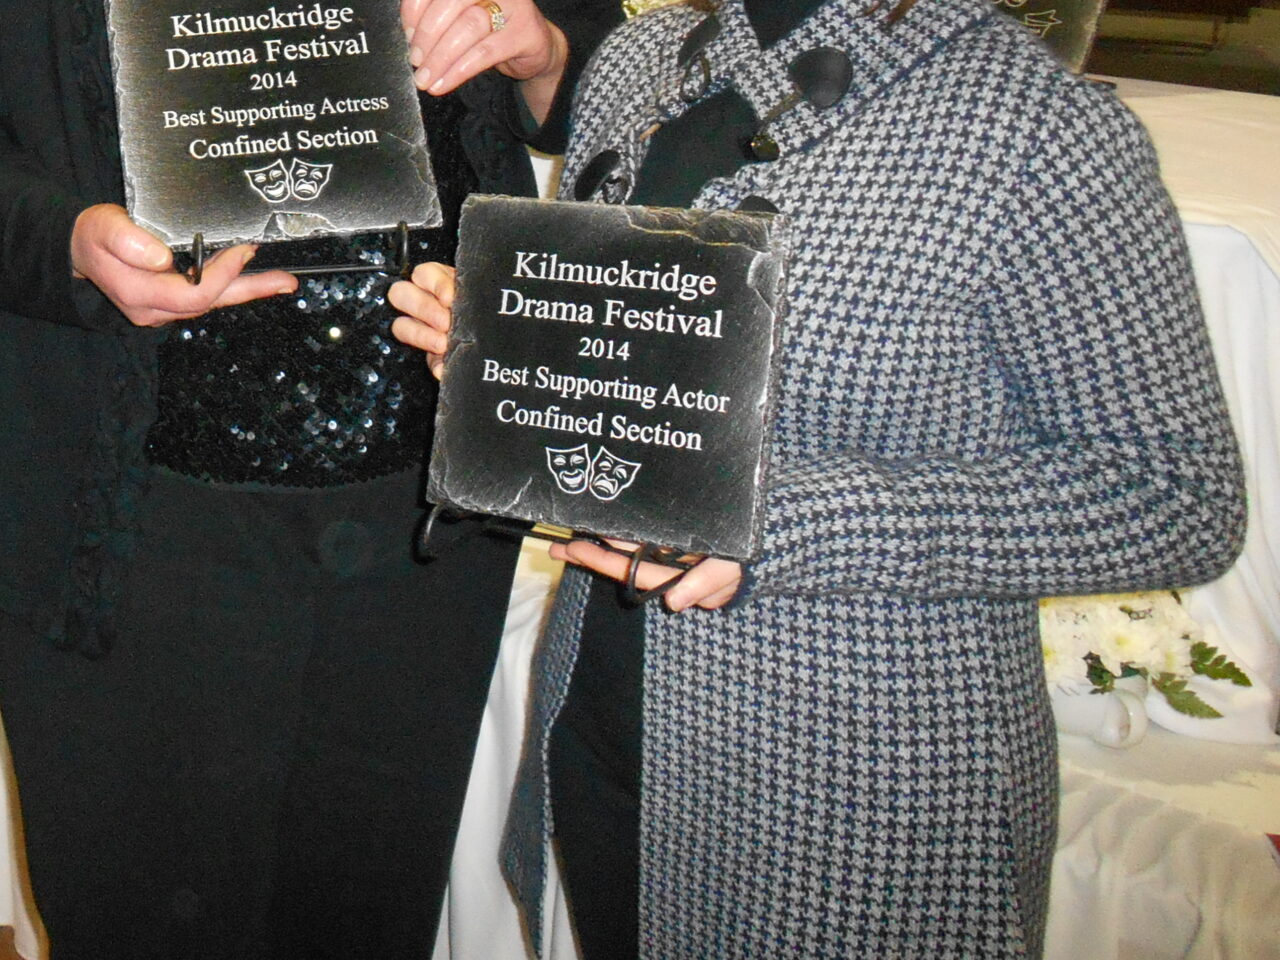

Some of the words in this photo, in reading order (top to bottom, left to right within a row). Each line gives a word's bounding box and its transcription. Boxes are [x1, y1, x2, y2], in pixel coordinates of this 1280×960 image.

[170, 3, 354, 38] Kilmuckridge
[165, 47, 258, 70] Drama
[264, 31, 370, 62] Festival
[250, 70, 297, 90] 2014
[162, 109, 206, 128] Best
[210, 99, 316, 126] Supporting
[320, 95, 389, 116] Actress
[189, 131, 291, 159] Confined
[296, 126, 379, 150] Section
[513, 251, 717, 300] Kilmuckridge
[497, 289, 594, 325] Drama
[602, 298, 723, 338] Festival
[578, 337, 630, 361] 2014
[482, 359, 529, 386] Best
[534, 366, 658, 409] Supporting
[661, 383, 730, 413] Actor
[496, 399, 603, 436] Confined
[610, 415, 703, 451] Section
